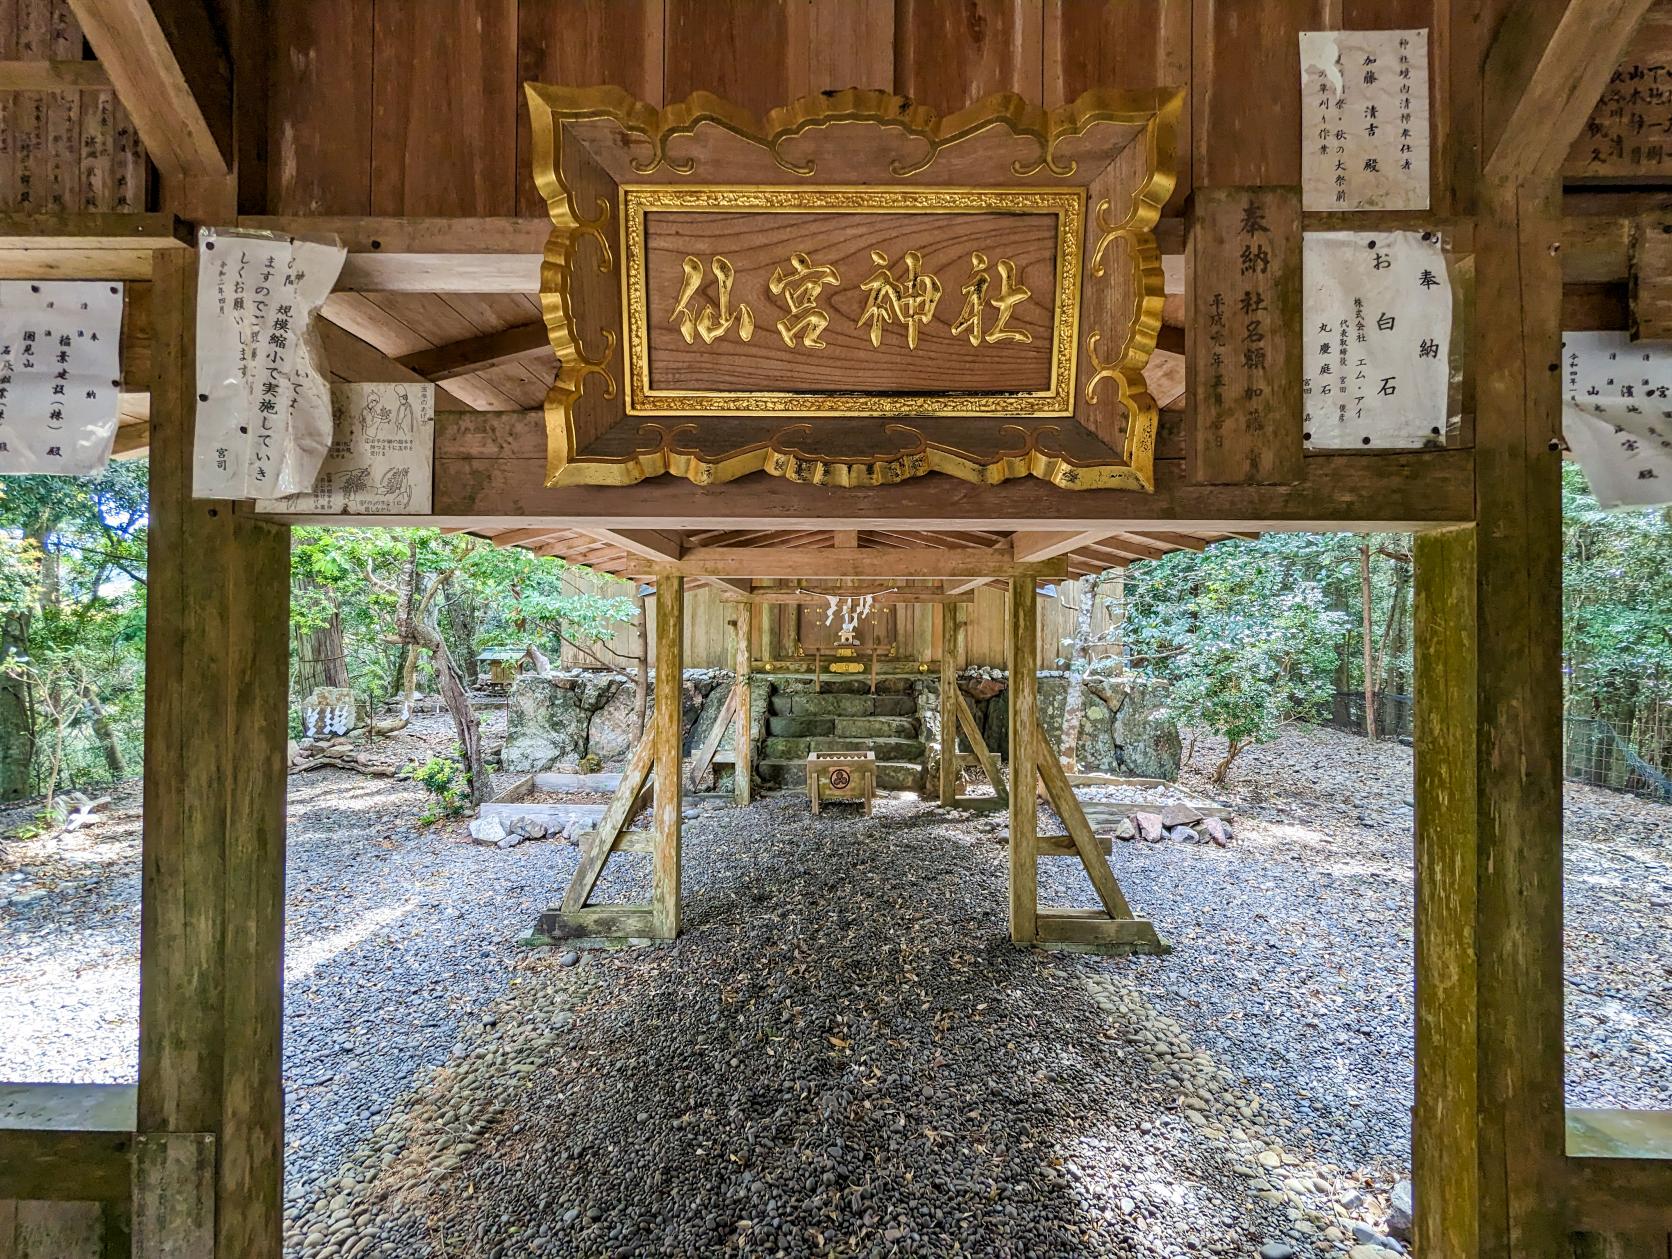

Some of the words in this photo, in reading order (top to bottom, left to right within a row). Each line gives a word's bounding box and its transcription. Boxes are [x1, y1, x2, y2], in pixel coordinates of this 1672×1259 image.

[1362, 55, 1378, 85] 加藤
[1364, 104, 1379, 138] 清吉
[1363, 158, 1380, 173] 殿
[668, 249, 1033, 351] 仙宮神社
[1353, 296, 1367, 343] 株式会社
[1373, 252, 1396, 397] お白石
[1419, 268, 1441, 360] 奉納
[85, 331, 100, 400] 奉納
[1318, 322, 1334, 396] 丸慶庭石
[1339, 319, 1350, 368] 代表取締役
[256, 304, 293, 482] 規模縮小で実施していき
[1355, 358, 1367, 420] エム・アイ
[216, 447, 228, 472] 宮司
